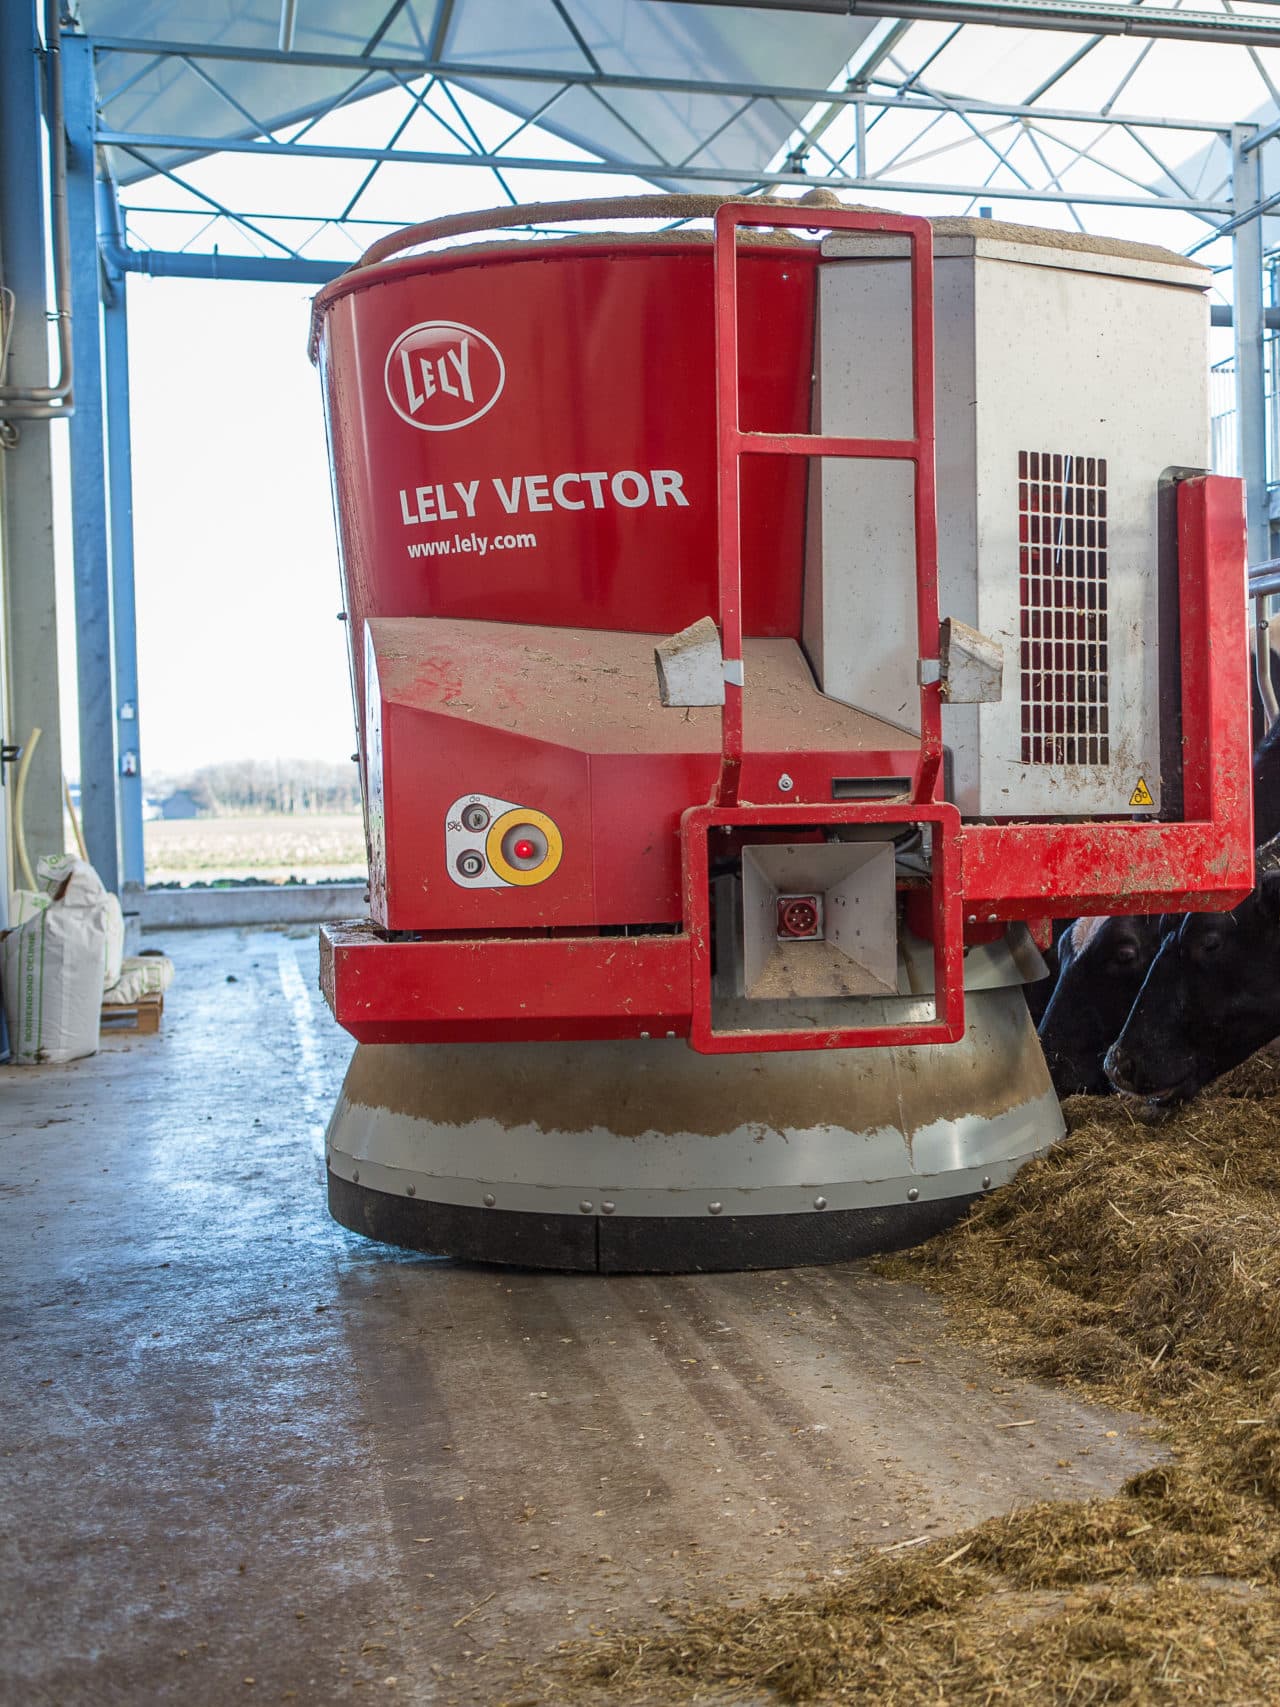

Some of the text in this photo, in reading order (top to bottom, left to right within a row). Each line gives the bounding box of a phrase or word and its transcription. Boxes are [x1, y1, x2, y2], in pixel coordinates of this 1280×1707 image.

[400, 336, 475, 415] LELY
[399, 469, 690, 526] LELY VECTOR
[406, 532, 537, 559] www.lely.com
